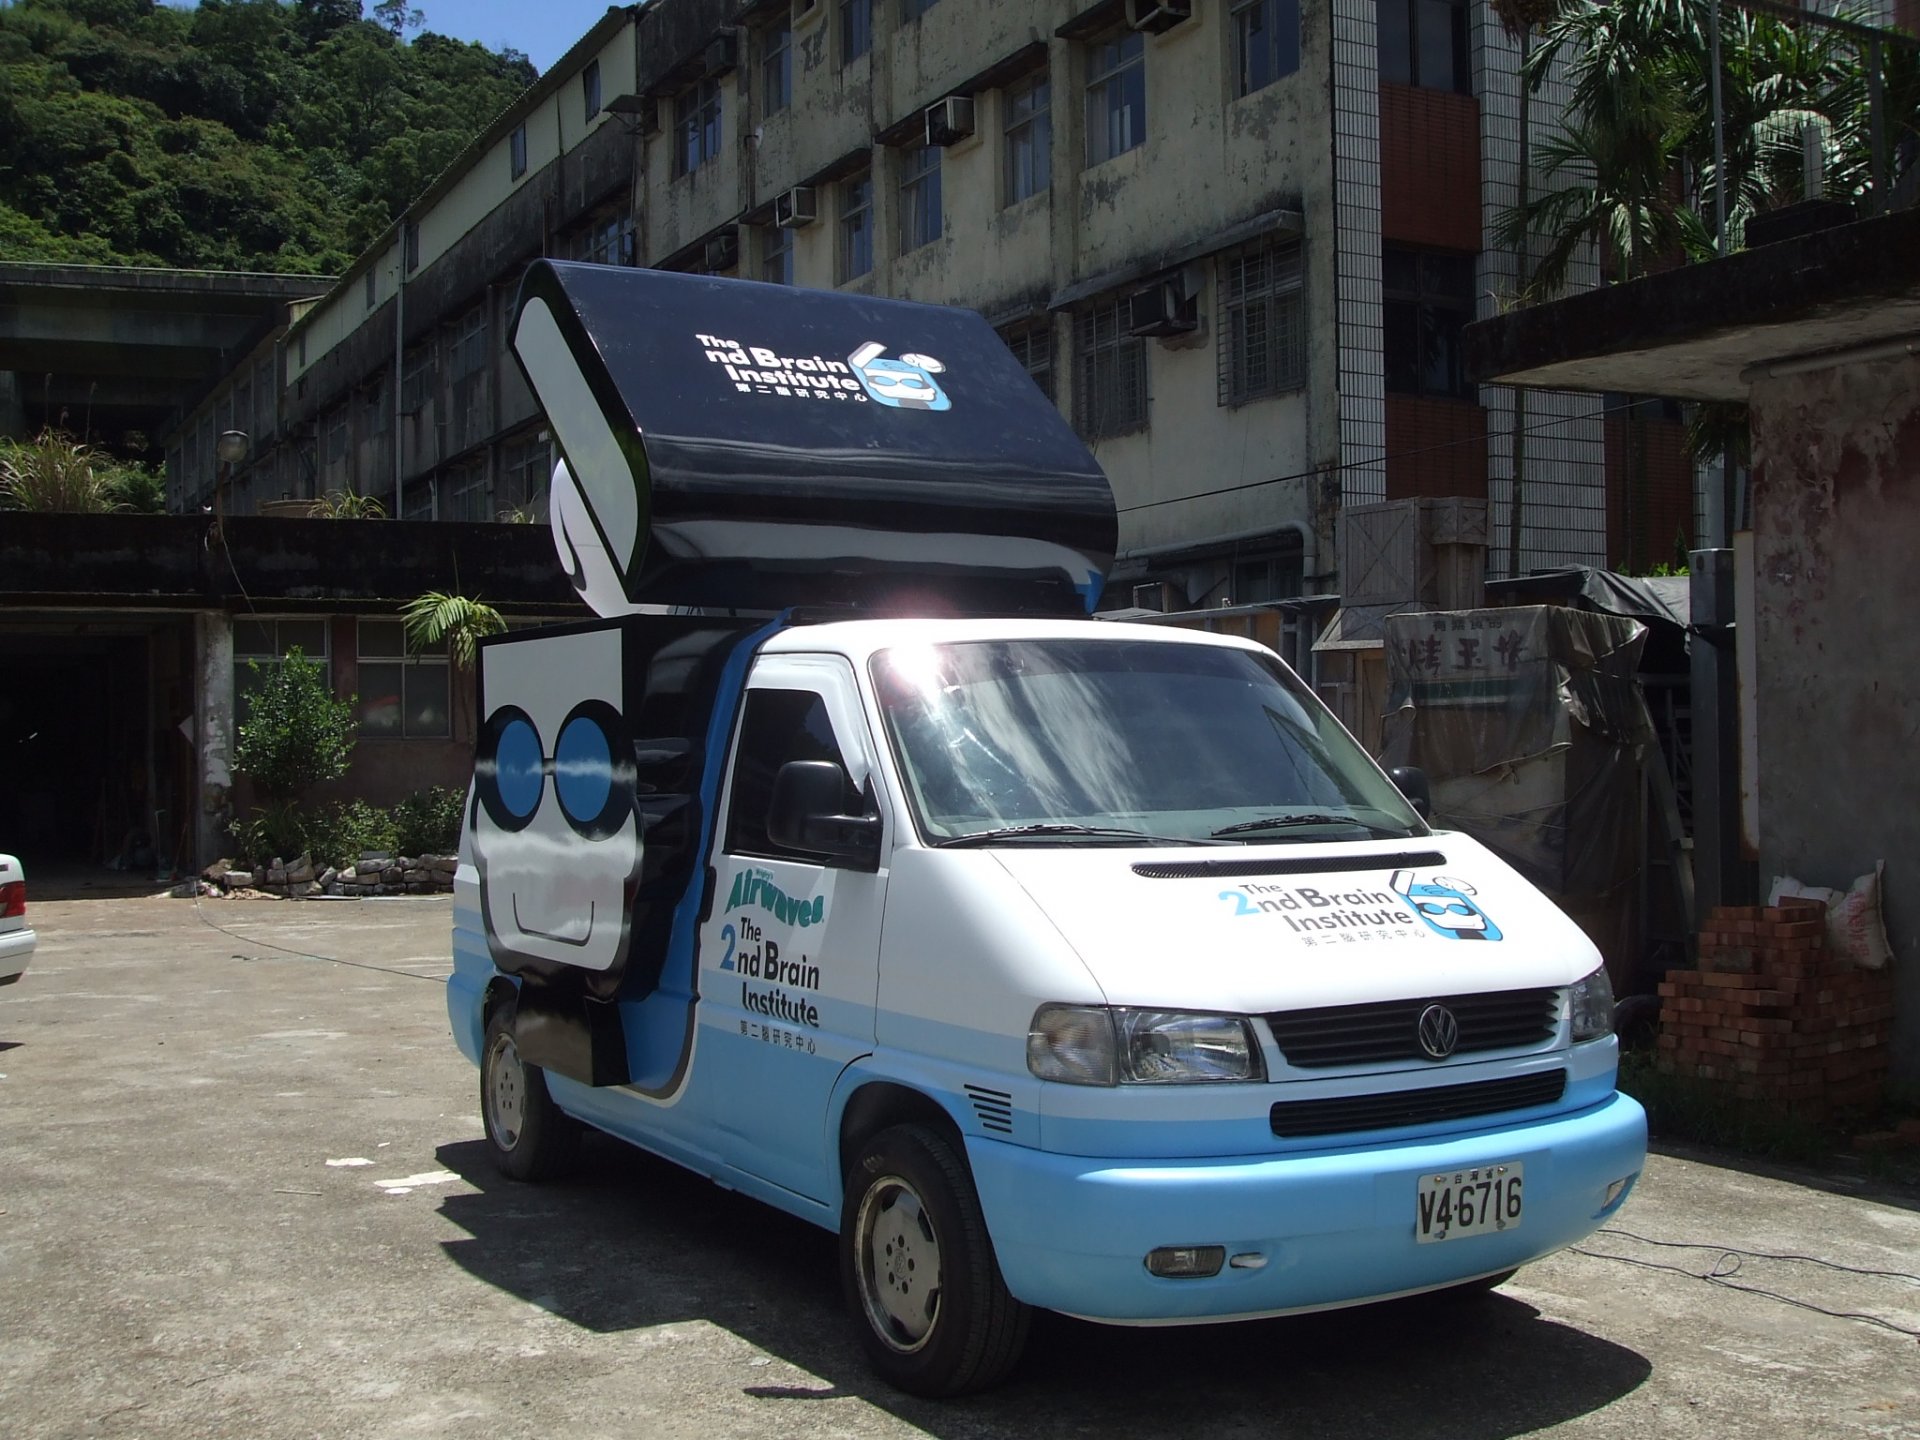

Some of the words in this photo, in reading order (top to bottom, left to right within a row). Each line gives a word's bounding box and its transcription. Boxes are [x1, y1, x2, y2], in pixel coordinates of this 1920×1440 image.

[695, 334, 740, 349] The
[749, 347, 849, 374] Brain
[724, 364, 860, 391] Institute
[724, 868, 824, 928] Airwaves
[1239, 884, 1283, 896] The
[1295, 887, 1394, 908] Brain
[741, 917, 761, 942] The
[1282, 908, 1413, 932] Institute
[764, 940, 819, 990] Brain
[742, 982, 819, 1028] Institute
